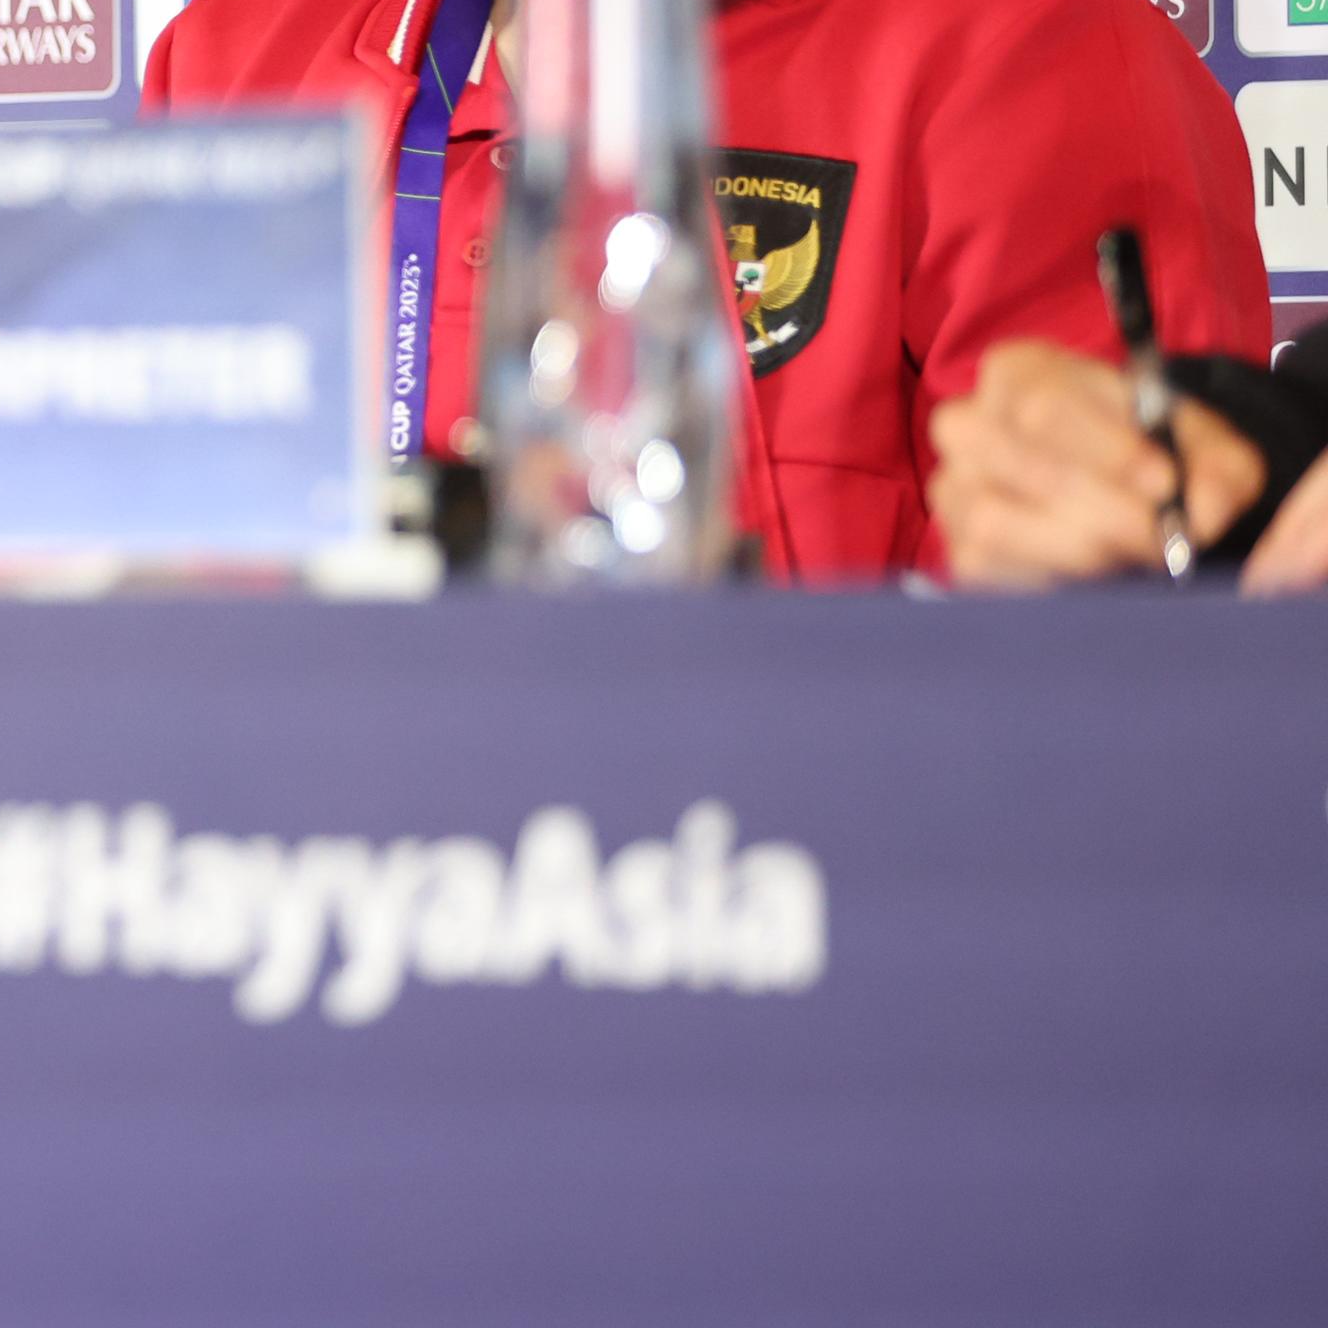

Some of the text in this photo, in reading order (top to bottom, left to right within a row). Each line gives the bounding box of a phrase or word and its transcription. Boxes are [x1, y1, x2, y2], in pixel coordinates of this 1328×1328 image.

[712, 175, 821, 210] DONESIA
[395, 321, 417, 395] QATAR
[391, 400, 412, 450] CUP
